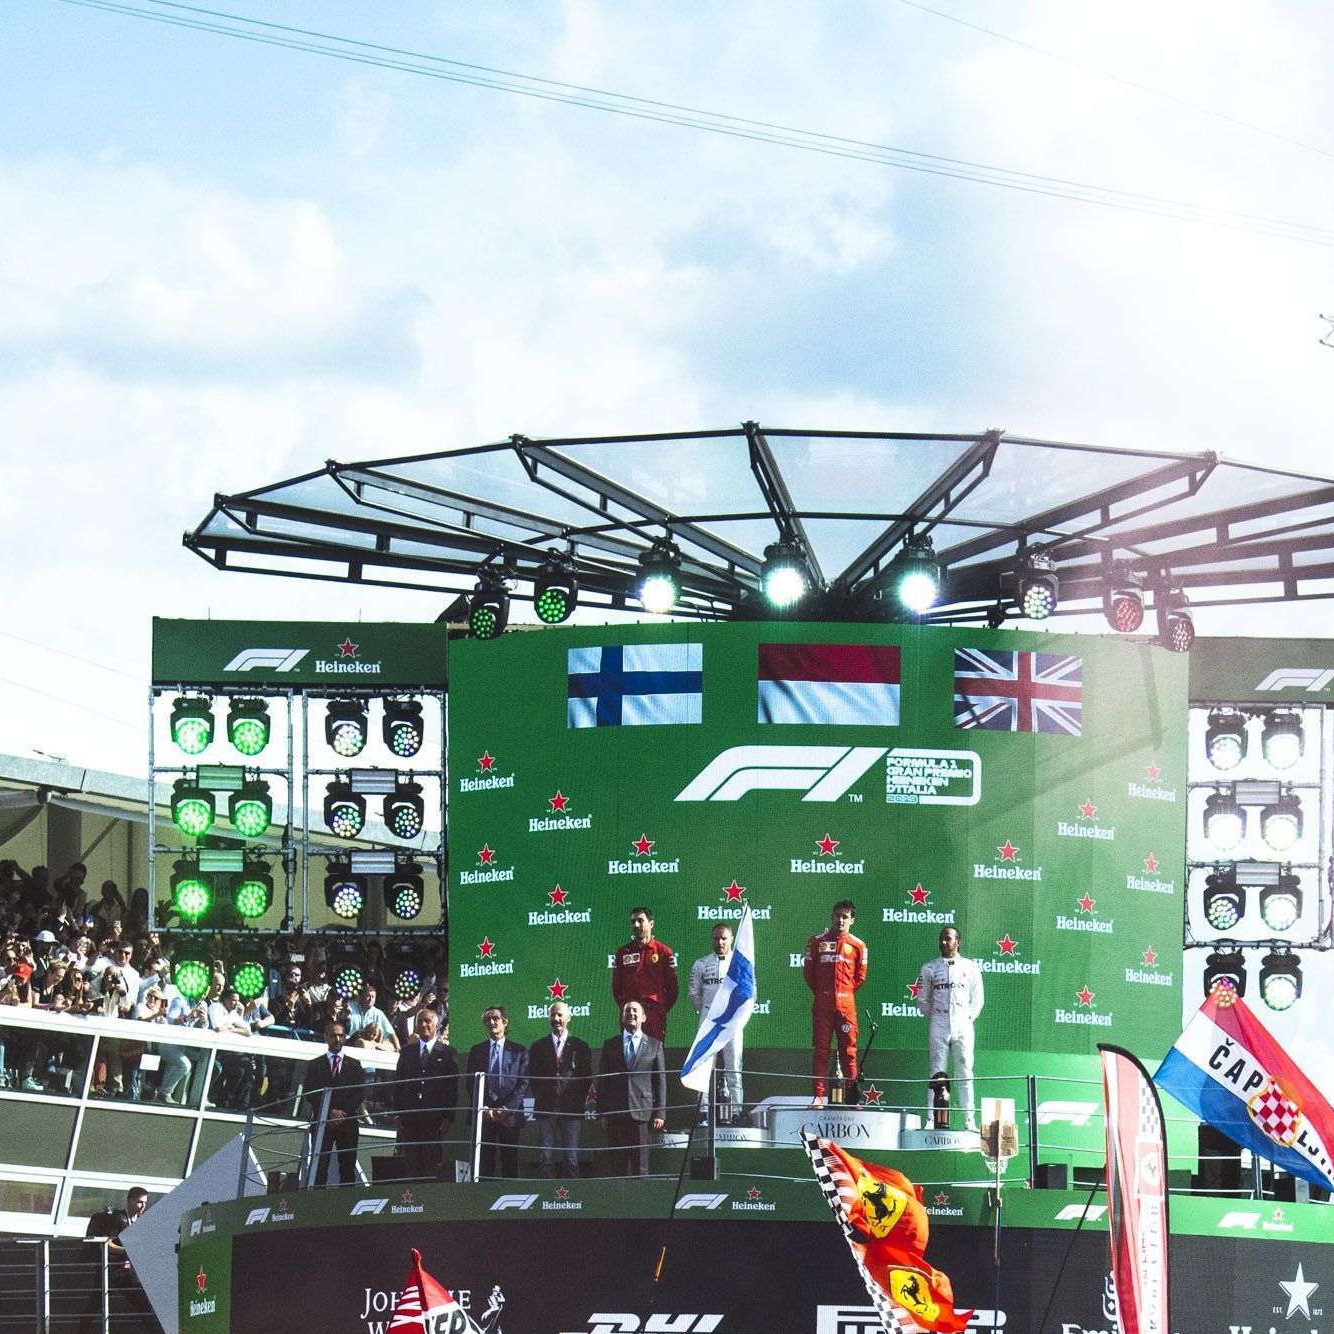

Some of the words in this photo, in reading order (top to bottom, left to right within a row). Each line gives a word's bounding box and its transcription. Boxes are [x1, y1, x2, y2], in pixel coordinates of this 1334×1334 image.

[315, 660, 380, 674] Heineken
[886, 766, 923, 776] GRAN
[887, 757, 948, 769] FORMULA
[674, 745, 889, 802] F1
[887, 775, 949, 786] HEINEKEN
[460, 774, 515, 792] Heineken
[1128, 783, 1176, 802] Heineken
[528, 815, 592, 832] Heineken
[1058, 822, 1115, 840] Heineken
[607, 859, 680, 875] Heineken
[790, 859, 865, 874] Heineken
[973, 864, 1042, 881] Heineken
[460, 867, 514, 885] Heineken
[1126, 876, 1175, 894] Heineken
[528, 909, 591, 926] Heineken
[882, 908, 956, 924] Heineken
[1056, 916, 1114, 934] Heineken
[460, 960, 514, 978] Heineken
[1125, 968, 1173, 987] Heineken
[528, 1002, 591, 1019] Heiken
[1055, 1009, 1113, 1027] Heineken
[790, 1122, 871, 1140] CARBON
[924, 1135, 962, 1146] CARBON
[391, 1204, 424, 1214] Heineken
[542, 1201, 582, 1210] Heineken
[732, 1201, 776, 1211] Heineken
[925, 1206, 964, 1217] eineken
[189, 1297, 216, 1317] Heineken
[360, 1288, 471, 1319] JOHIE
